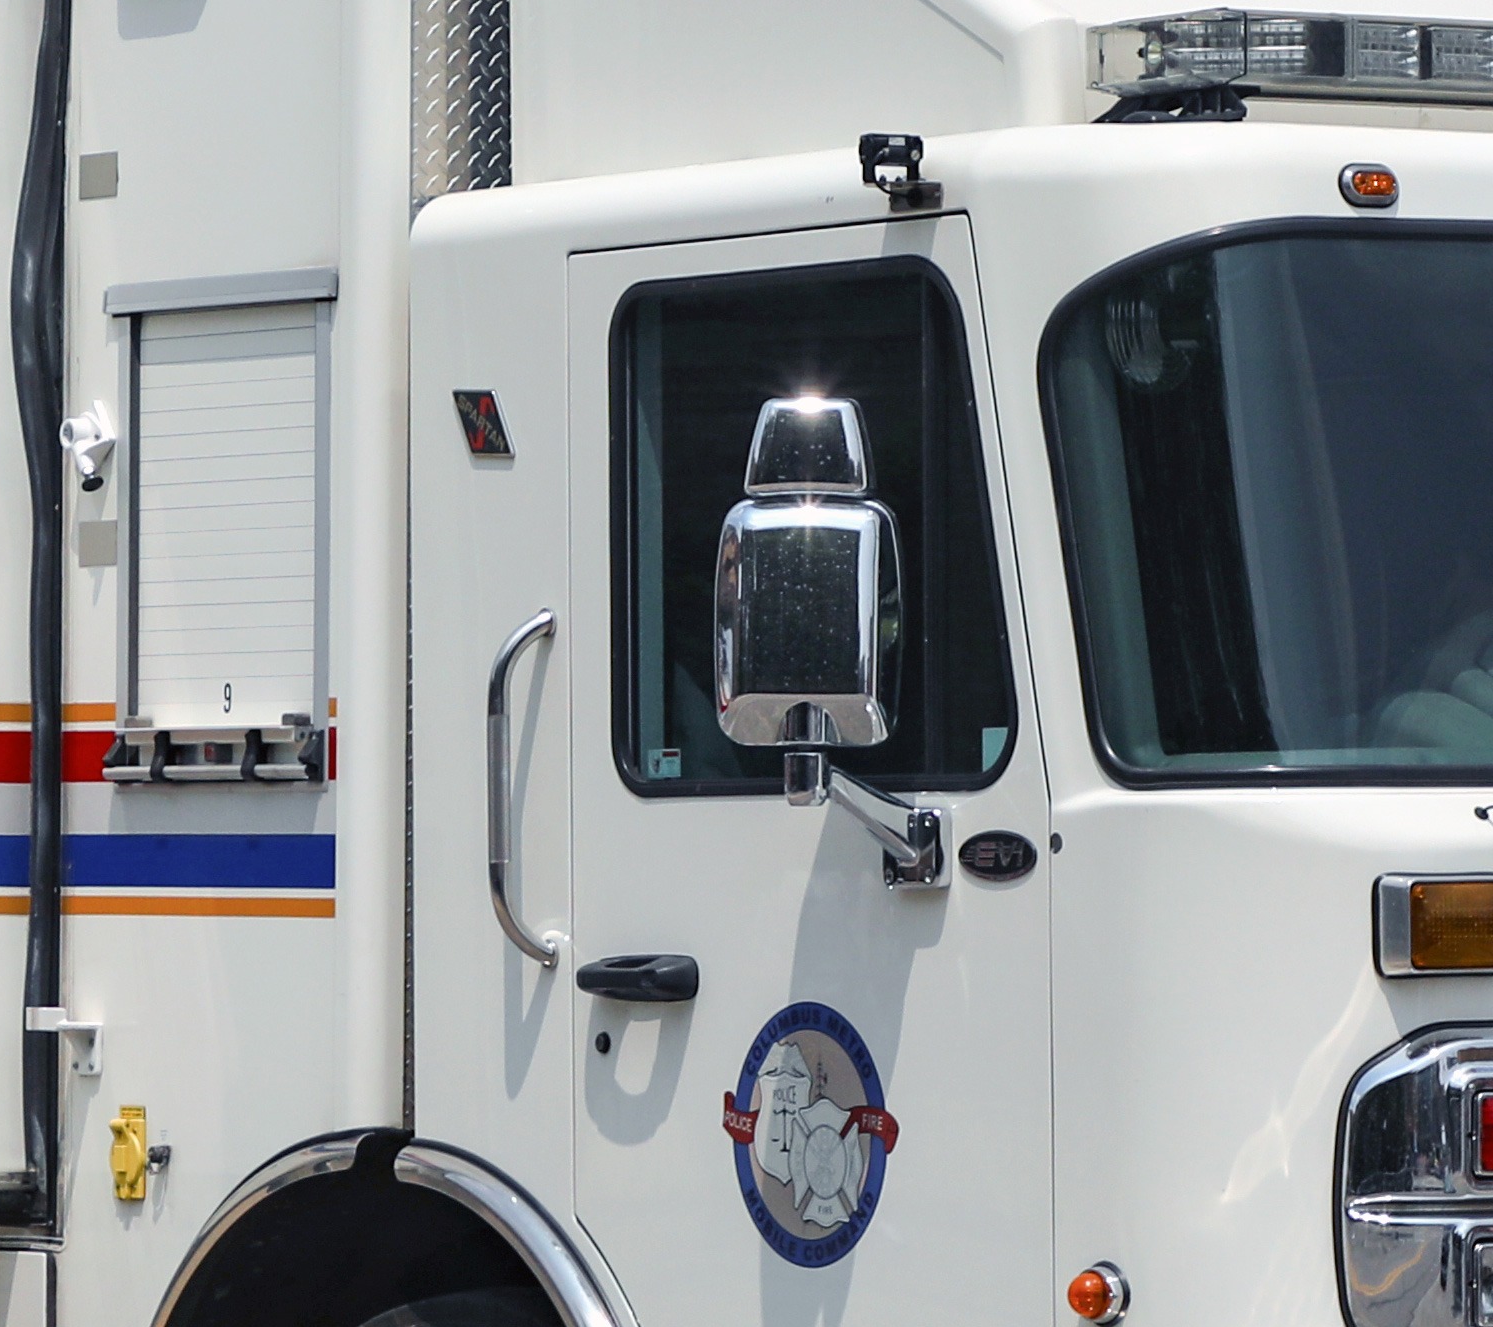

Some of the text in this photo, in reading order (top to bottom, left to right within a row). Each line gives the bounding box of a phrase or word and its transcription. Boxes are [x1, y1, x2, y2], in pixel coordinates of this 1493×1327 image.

[223, 682, 232, 714] 9
[746, 1009, 872, 1079] COLUMBUS METRO
[861, 1112, 884, 1131] FIRE
